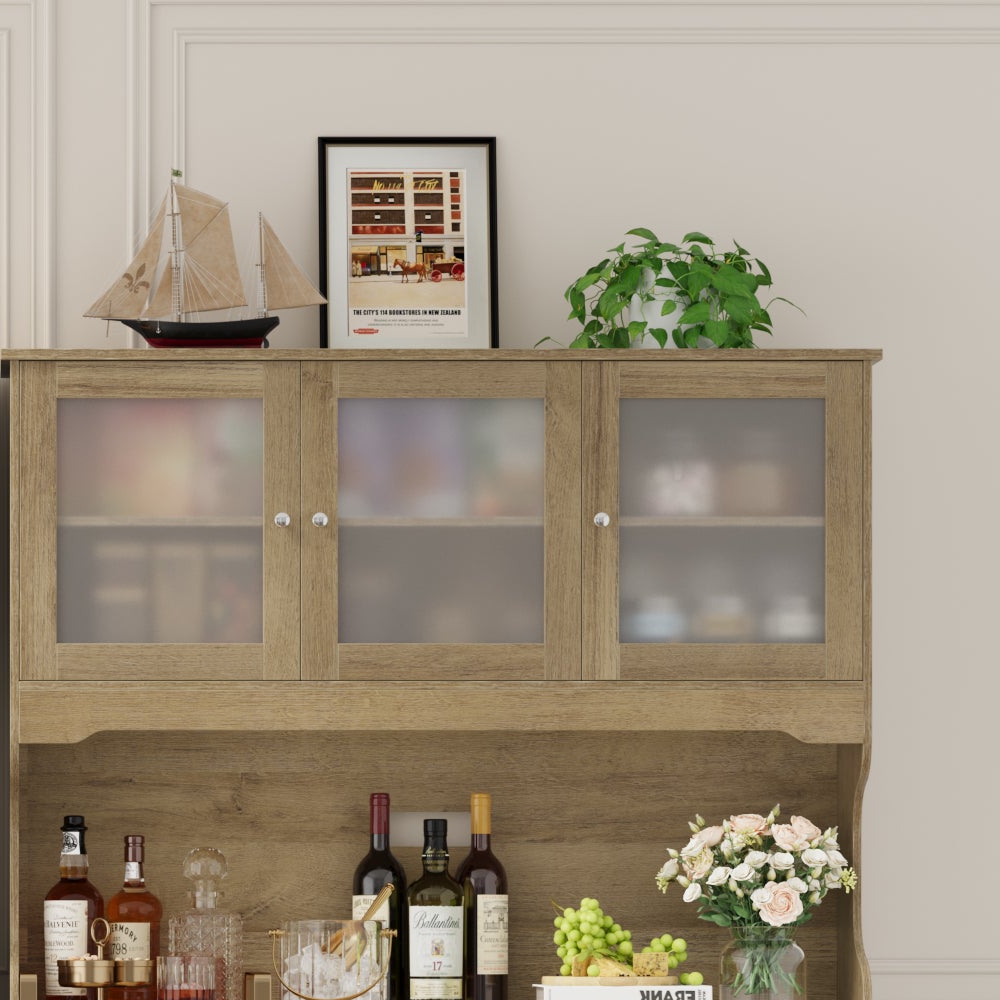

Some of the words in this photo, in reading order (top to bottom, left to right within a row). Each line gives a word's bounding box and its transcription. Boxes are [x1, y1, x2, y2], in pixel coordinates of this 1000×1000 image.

[109, 923, 138, 943] ERMORY
[111, 942, 128, 955] 798
[432, 961, 443, 971] 17
